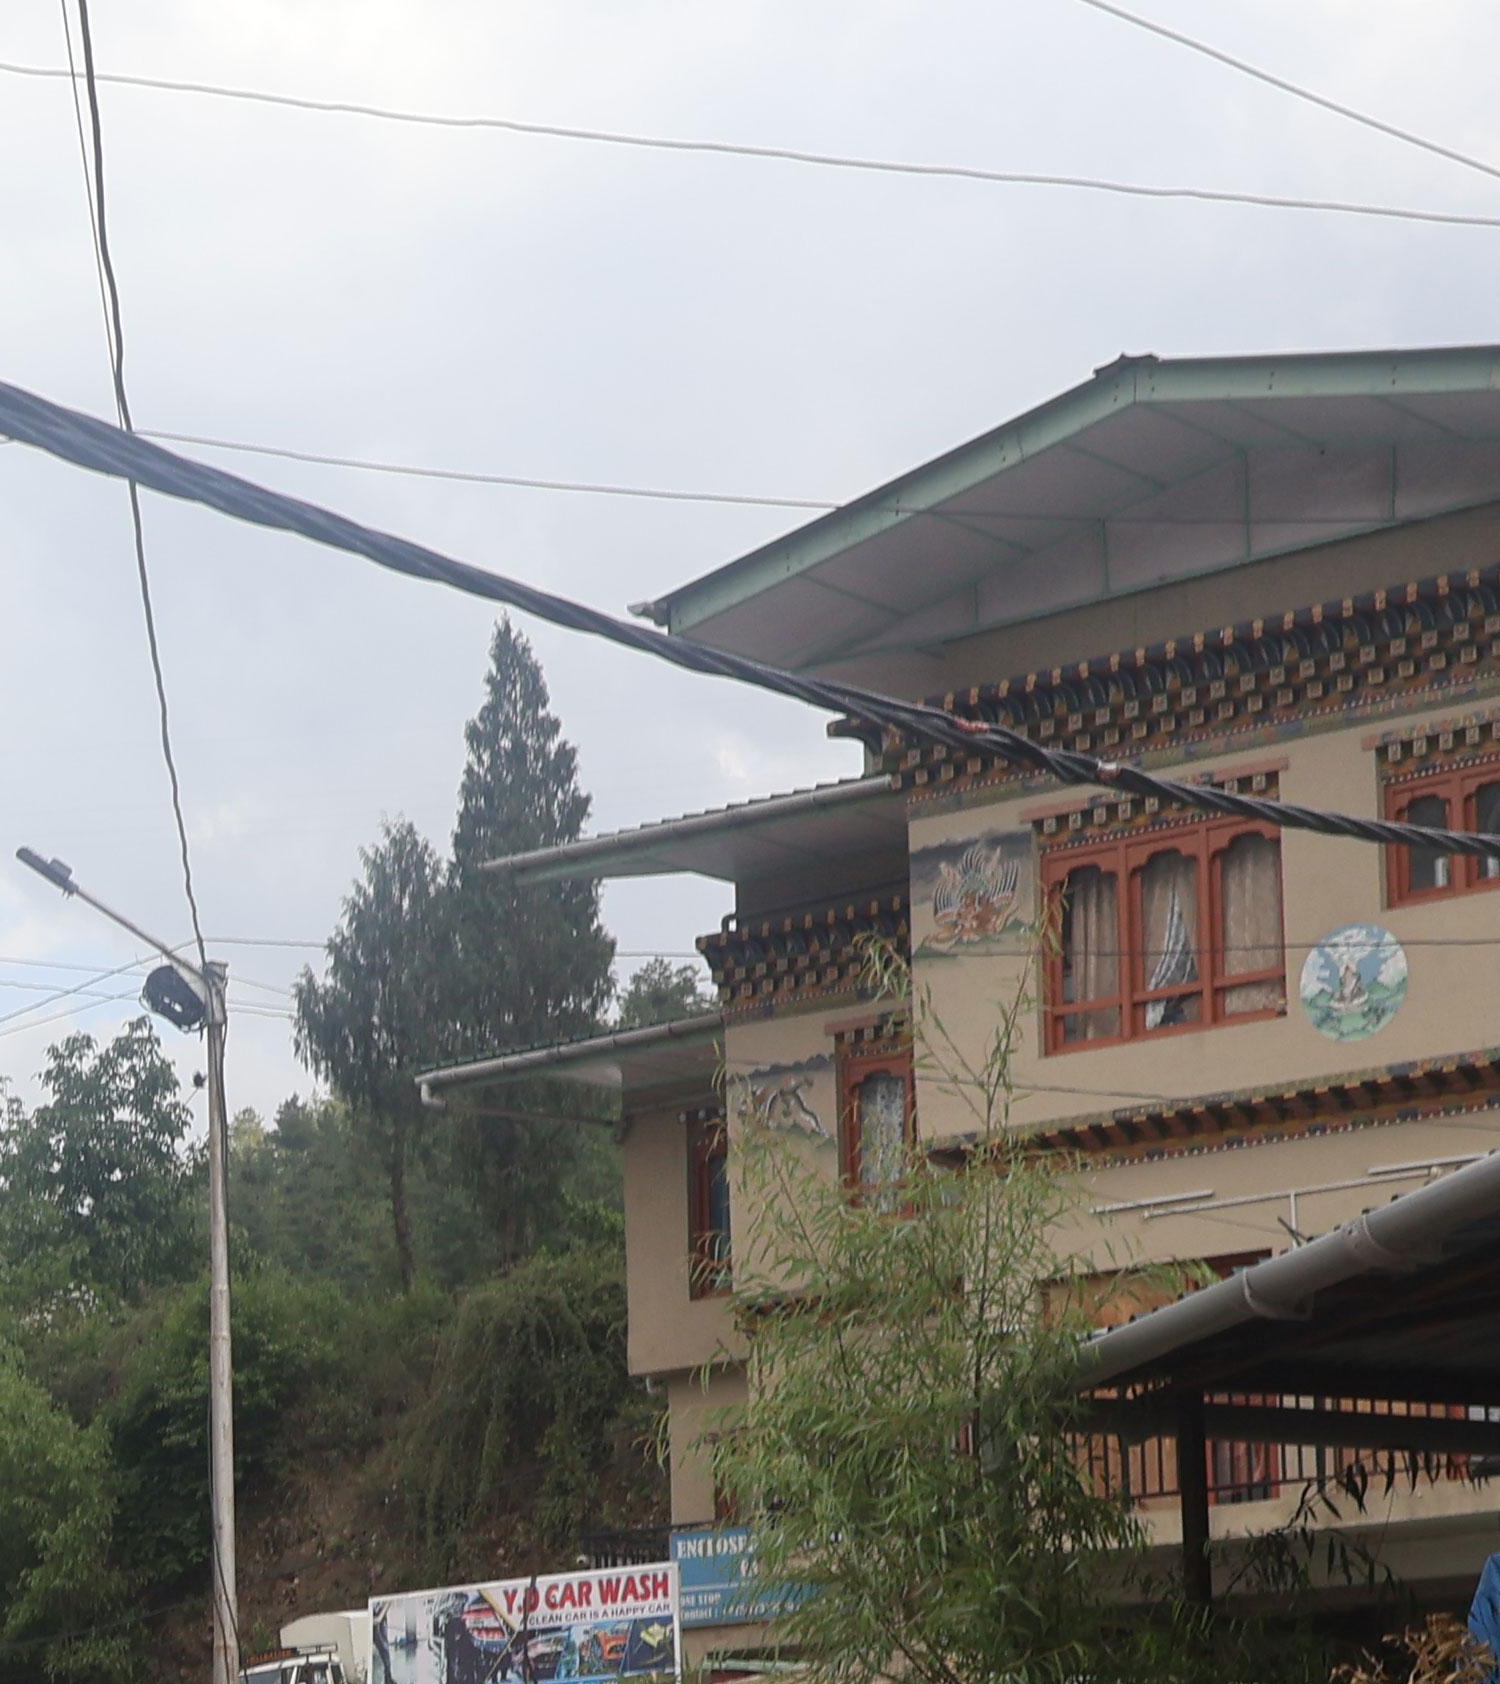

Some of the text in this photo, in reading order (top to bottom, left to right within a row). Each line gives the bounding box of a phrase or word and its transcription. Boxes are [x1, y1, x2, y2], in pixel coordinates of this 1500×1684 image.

[545, 1579, 593, 1611] CAR
[598, 1571, 669, 1606] WASH
[529, 1613, 562, 1627] CLEAN
[565, 1611, 586, 1622] CAR
[590, 1609, 599, 1620] IS
[601, 1608, 609, 1618] A
[611, 1605, 645, 1617] HAPPY
[648, 1603, 671, 1614] CAR
